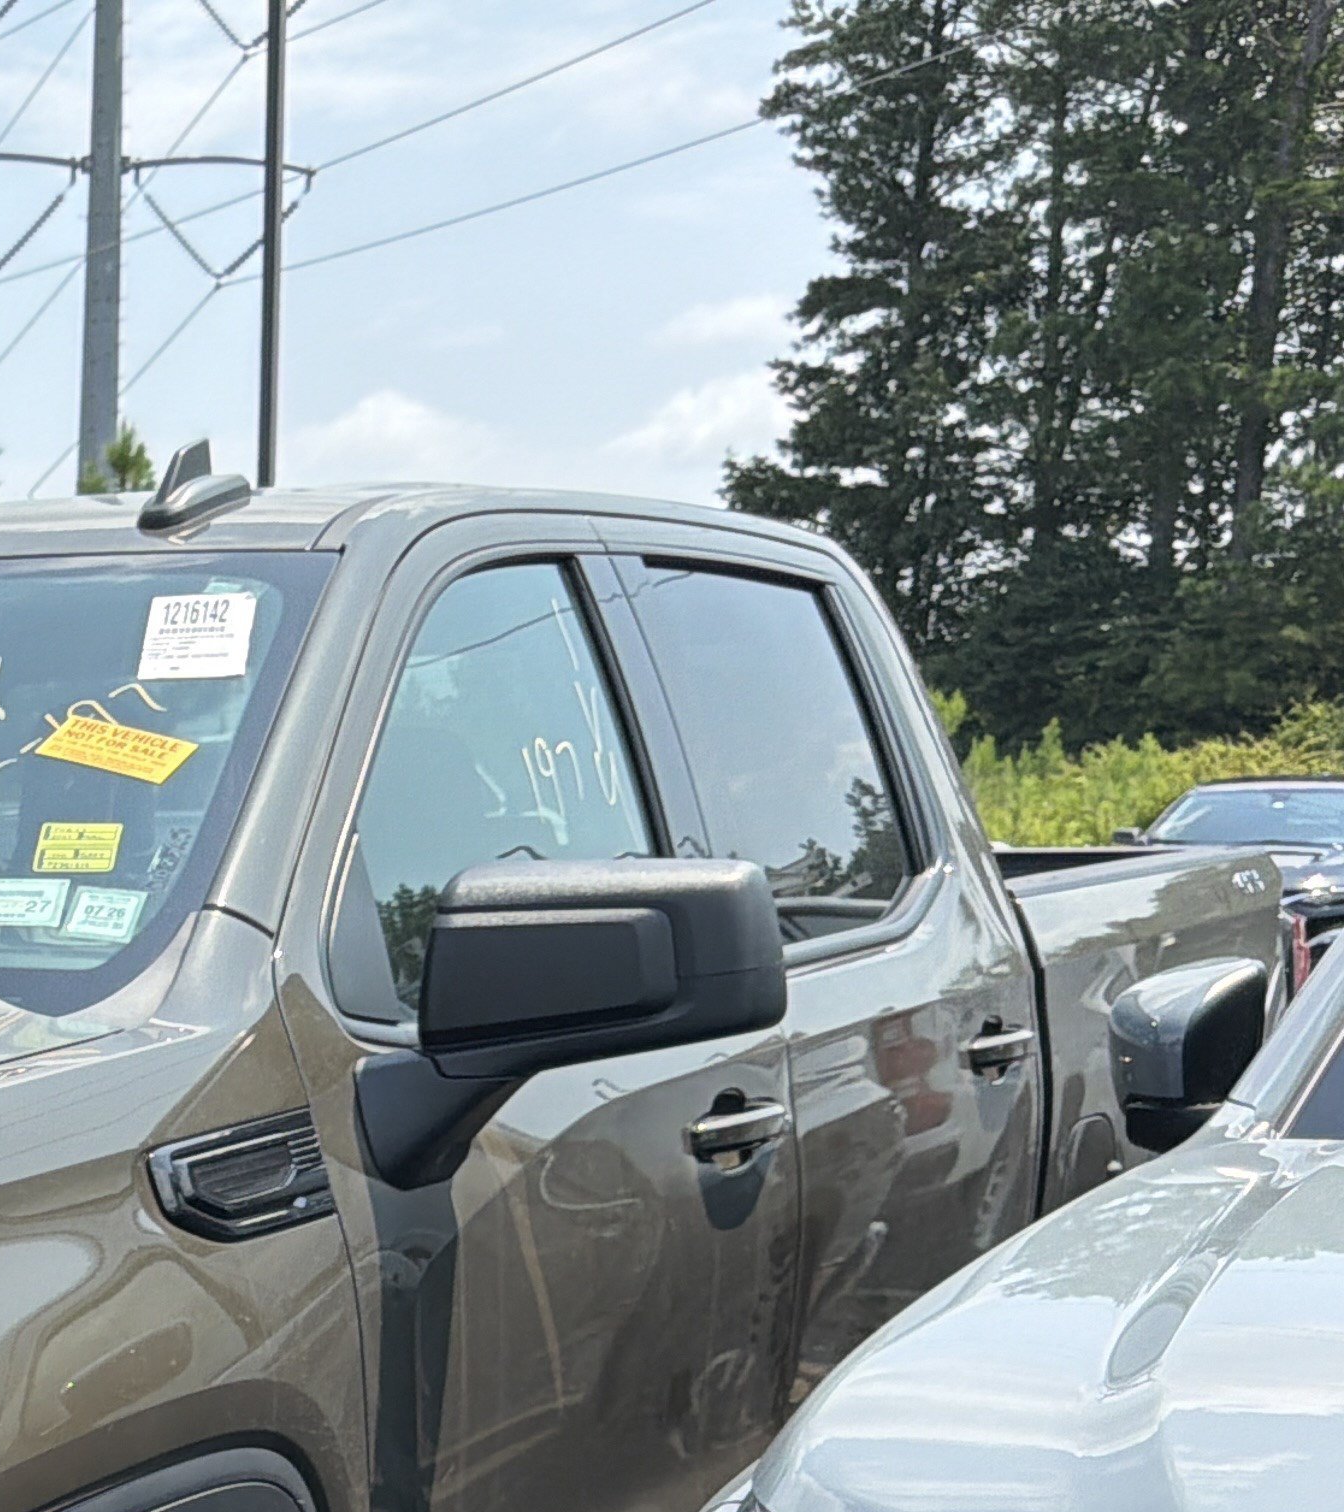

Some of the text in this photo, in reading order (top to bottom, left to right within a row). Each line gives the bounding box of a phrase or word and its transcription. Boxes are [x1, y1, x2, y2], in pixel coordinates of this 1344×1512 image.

[163, 599, 230, 626] 1216142
[63, 729, 96, 742] NOT
[95, 735, 128, 750] FOR
[129, 743, 169, 760] SALE
[70, 718, 183, 753] THIS VEHICLE
[24, 899, 53, 914] 27
